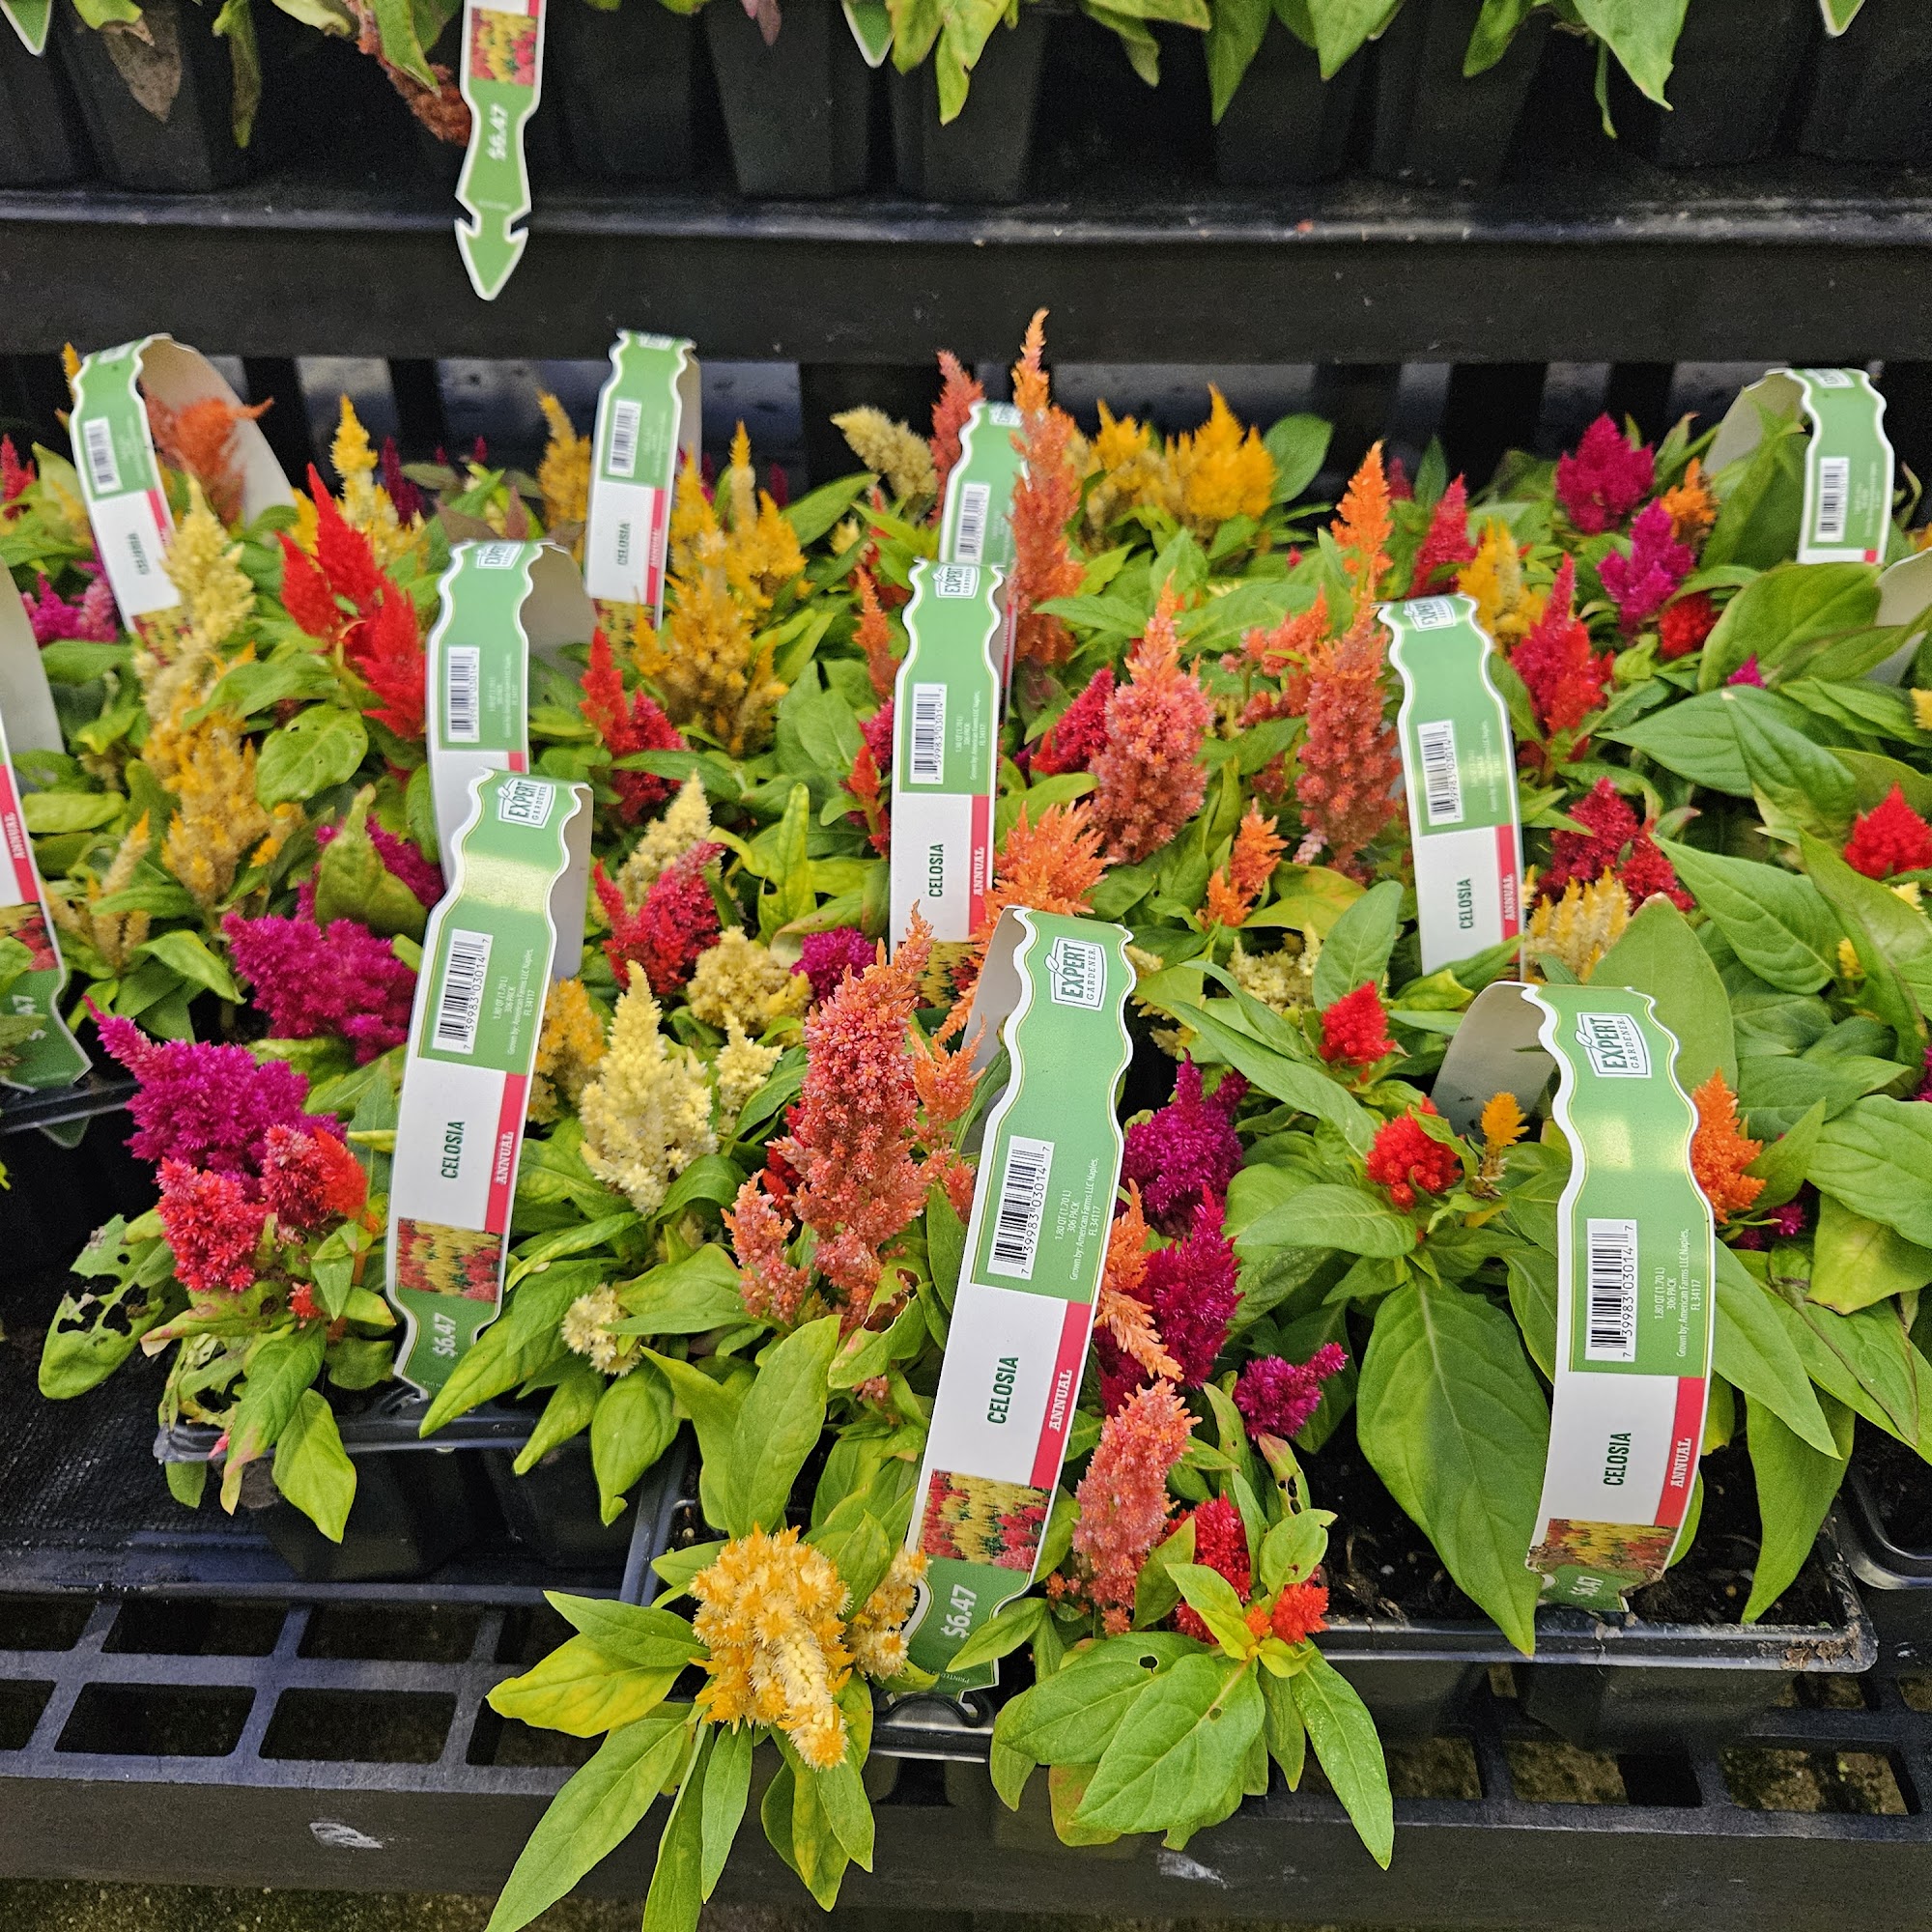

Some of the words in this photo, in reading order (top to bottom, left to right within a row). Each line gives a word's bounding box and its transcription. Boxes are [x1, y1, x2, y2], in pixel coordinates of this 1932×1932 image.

[508, 781, 538, 818] EXPERT
[4, 811, 25, 860] ANNUAL
[929, 844, 943, 896] CELOSIA
[973, 846, 984, 896] ANNUAL
[1457, 878, 1473, 929] CELOSIA
[1503, 873, 1516, 922] ANNUAL
[471, 955, 487, 991] 03014
[1061, 943, 1085, 999] EXPERT
[464, 996, 479, 1031] 39983
[1588, 1017, 1628, 1068] EXPERT
[440, 1121, 465, 1179] CELOSIA
[495, 1131, 514, 1184] ANNUAL
[1080, 1193, 1092, 1214] Farms
[1084, 1180, 1094, 1193] LLC
[1023, 1212, 1039, 1253] 39983
[1031, 1166, 1047, 1208] 03014
[1057, 1214, 1066, 1225] QT
[1066, 1218, 1077, 1232] 306
[1068, 1200, 1080, 1219] PACK
[1089, 1205, 1101, 1227] 34117
[1075, 1214, 1089, 1246] American
[1088, 1227, 1097, 1236] FL
[1068, 1257, 1081, 1280] Grown
[1622, 1247, 1634, 1289] 03014
[1679, 1256, 1688, 1266] LLC
[1679, 1268, 1688, 1289] Farms
[1655, 1293, 1664, 1303] QT
[1666, 1277, 1676, 1294] PACK
[1666, 1295, 1676, 1309] 306
[1690, 1279, 1700, 1301] 34117
[1622, 1295, 1633, 1336] 39983
[1678, 1291, 1688, 1322] American
[1690, 1301, 1700, 1310] FL
[433, 1312, 458, 1357] $6.47
[1676, 1335, 1686, 1356] Grown
[986, 1356, 1019, 1425] CELOSIA
[1049, 1369, 1073, 1432] ANNUAL
[1604, 1432, 1632, 1487] CELOSIA
[1671, 1437, 1692, 1488] ANNUAL
[1569, 1576, 1604, 1597] $6.47
[941, 1584, 978, 1638] $6.47
